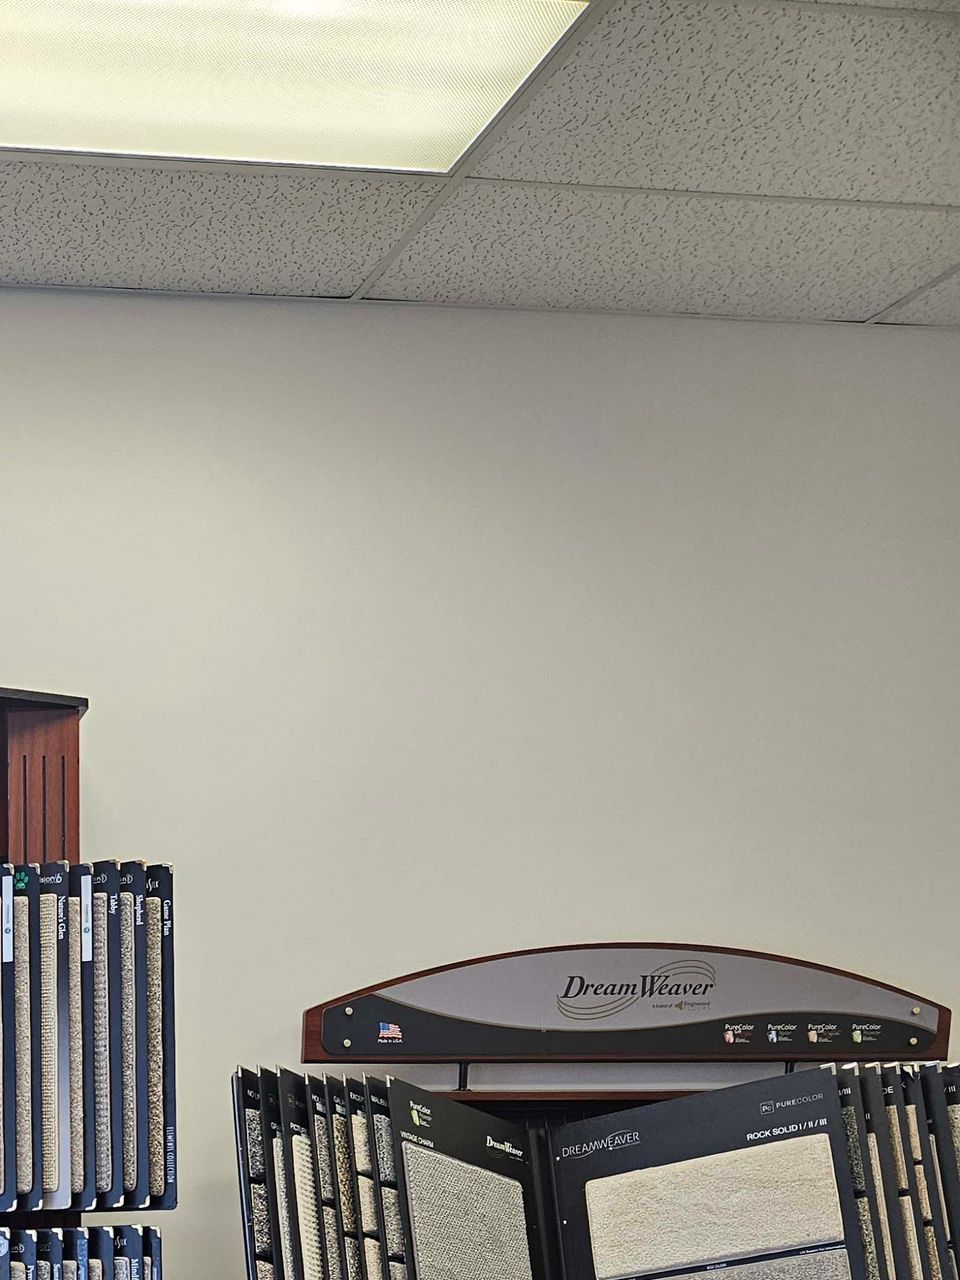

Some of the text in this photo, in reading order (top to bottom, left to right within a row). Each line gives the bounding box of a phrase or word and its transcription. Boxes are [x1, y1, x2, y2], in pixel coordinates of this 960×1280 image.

[109, 893, 118, 915] Tabby
[134, 894, 143, 926] Shepherd
[58, 895, 66, 940] Nature's Glen
[163, 900, 171, 936] Game Plan
[560, 974, 714, 999] DreamWeaver
[776, 1093, 824, 1108] PURECOLOR
[561, 1131, 640, 1158] DREAMWEAVER
[746, 1129, 772, 1141] ROCK
[772, 1124, 798, 1136] SOLID
[486, 1135, 524, 1157] DreamWeaver
